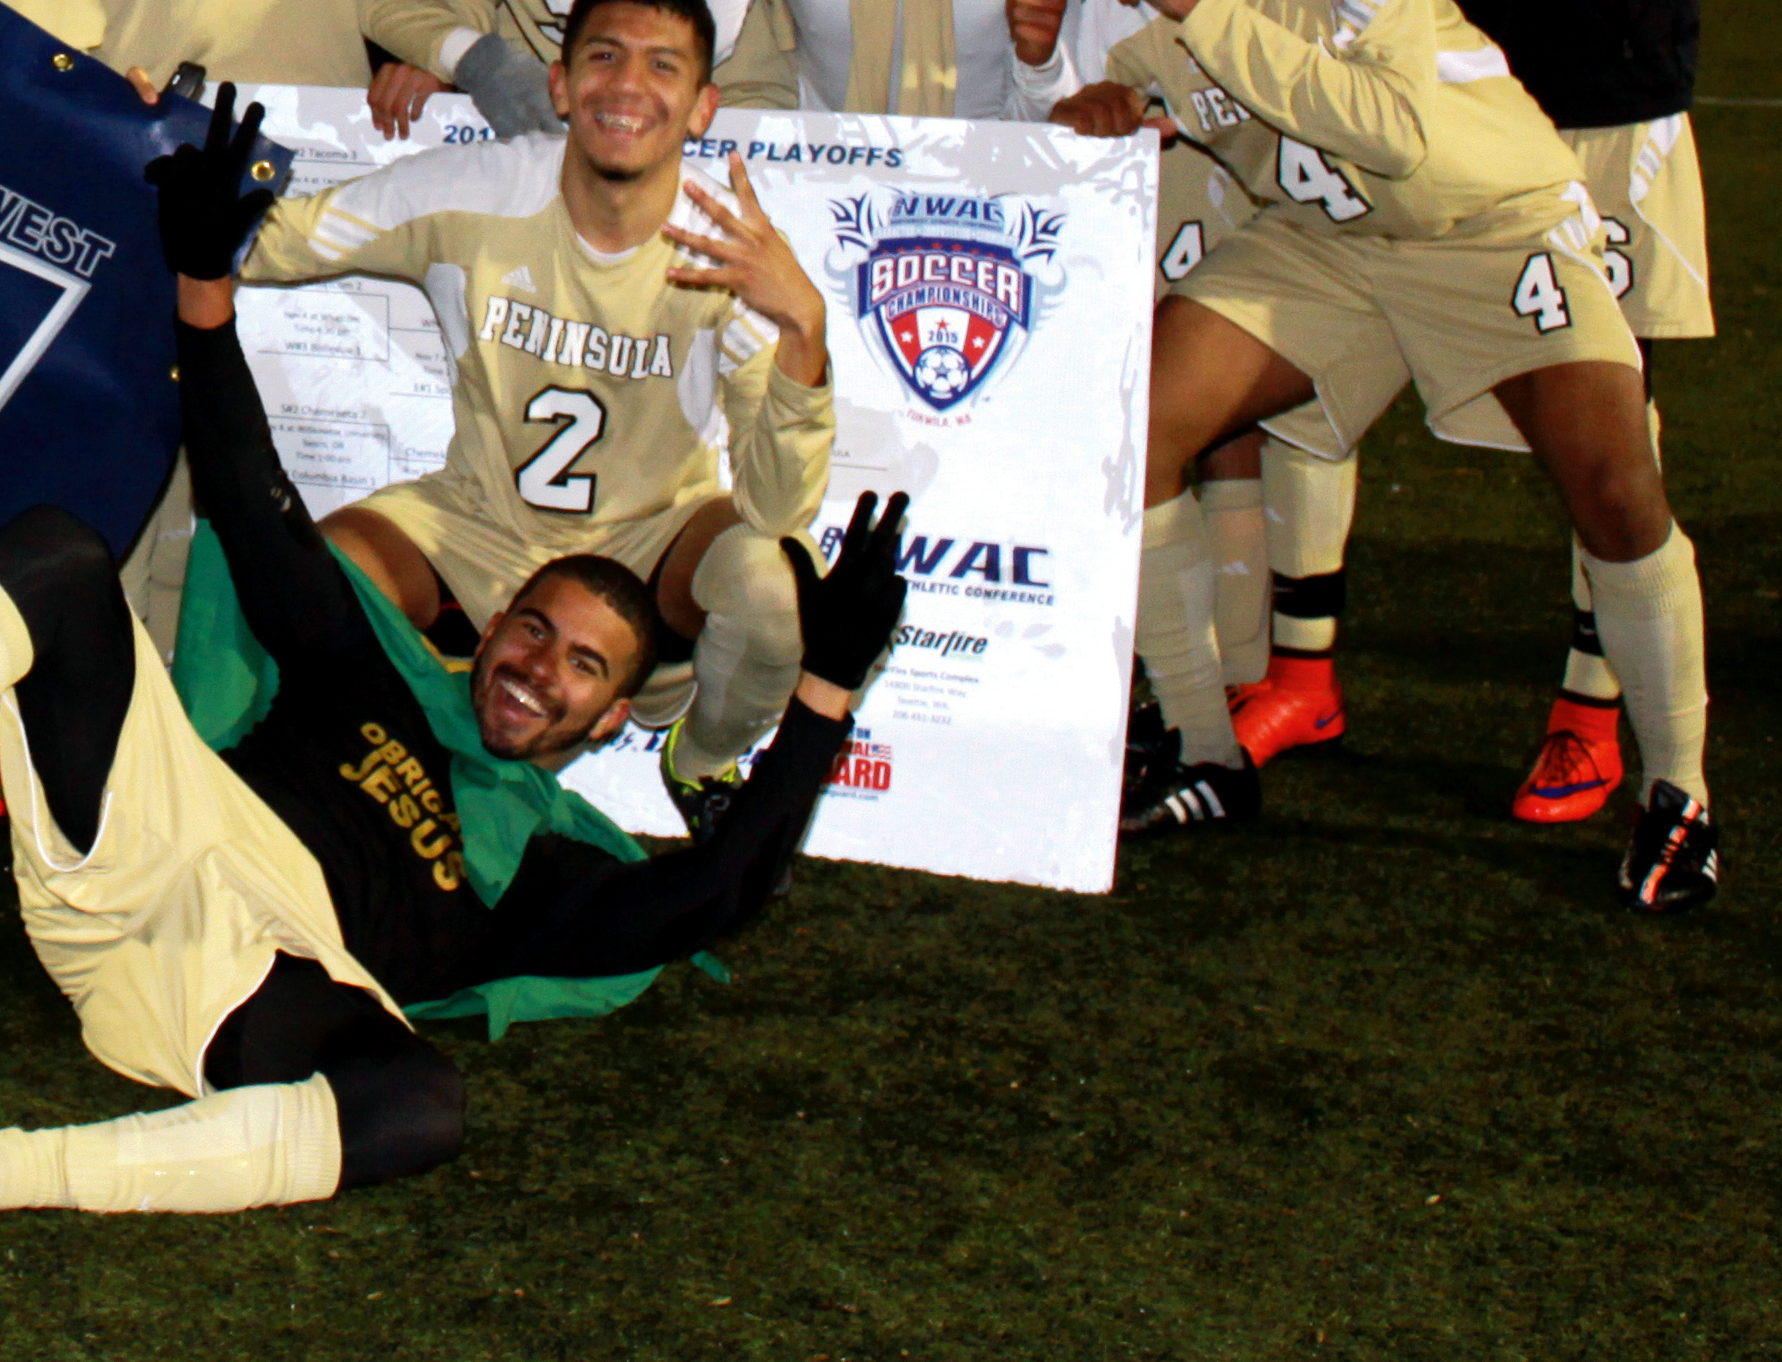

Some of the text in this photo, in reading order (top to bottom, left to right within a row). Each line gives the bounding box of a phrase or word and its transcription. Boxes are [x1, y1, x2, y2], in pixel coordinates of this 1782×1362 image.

[746, 141, 903, 168] PLAYOFFS
[1276, 134, 1374, 224] 4
[870, 252, 1021, 315] SOCCER
[886, 286, 1006, 329] CHAMPIONSHIPS
[1510, 251, 1573, 335] 4
[478, 294, 674, 380] PENINSULA
[927, 329, 959, 344] 2015
[514, 383, 608, 514] 2
[964, 586, 1055, 606] CONFERENCE
[896, 624, 989, 657] Starfire
[831, 755, 892, 792] ARD
[338, 749, 468, 893] JESUS
